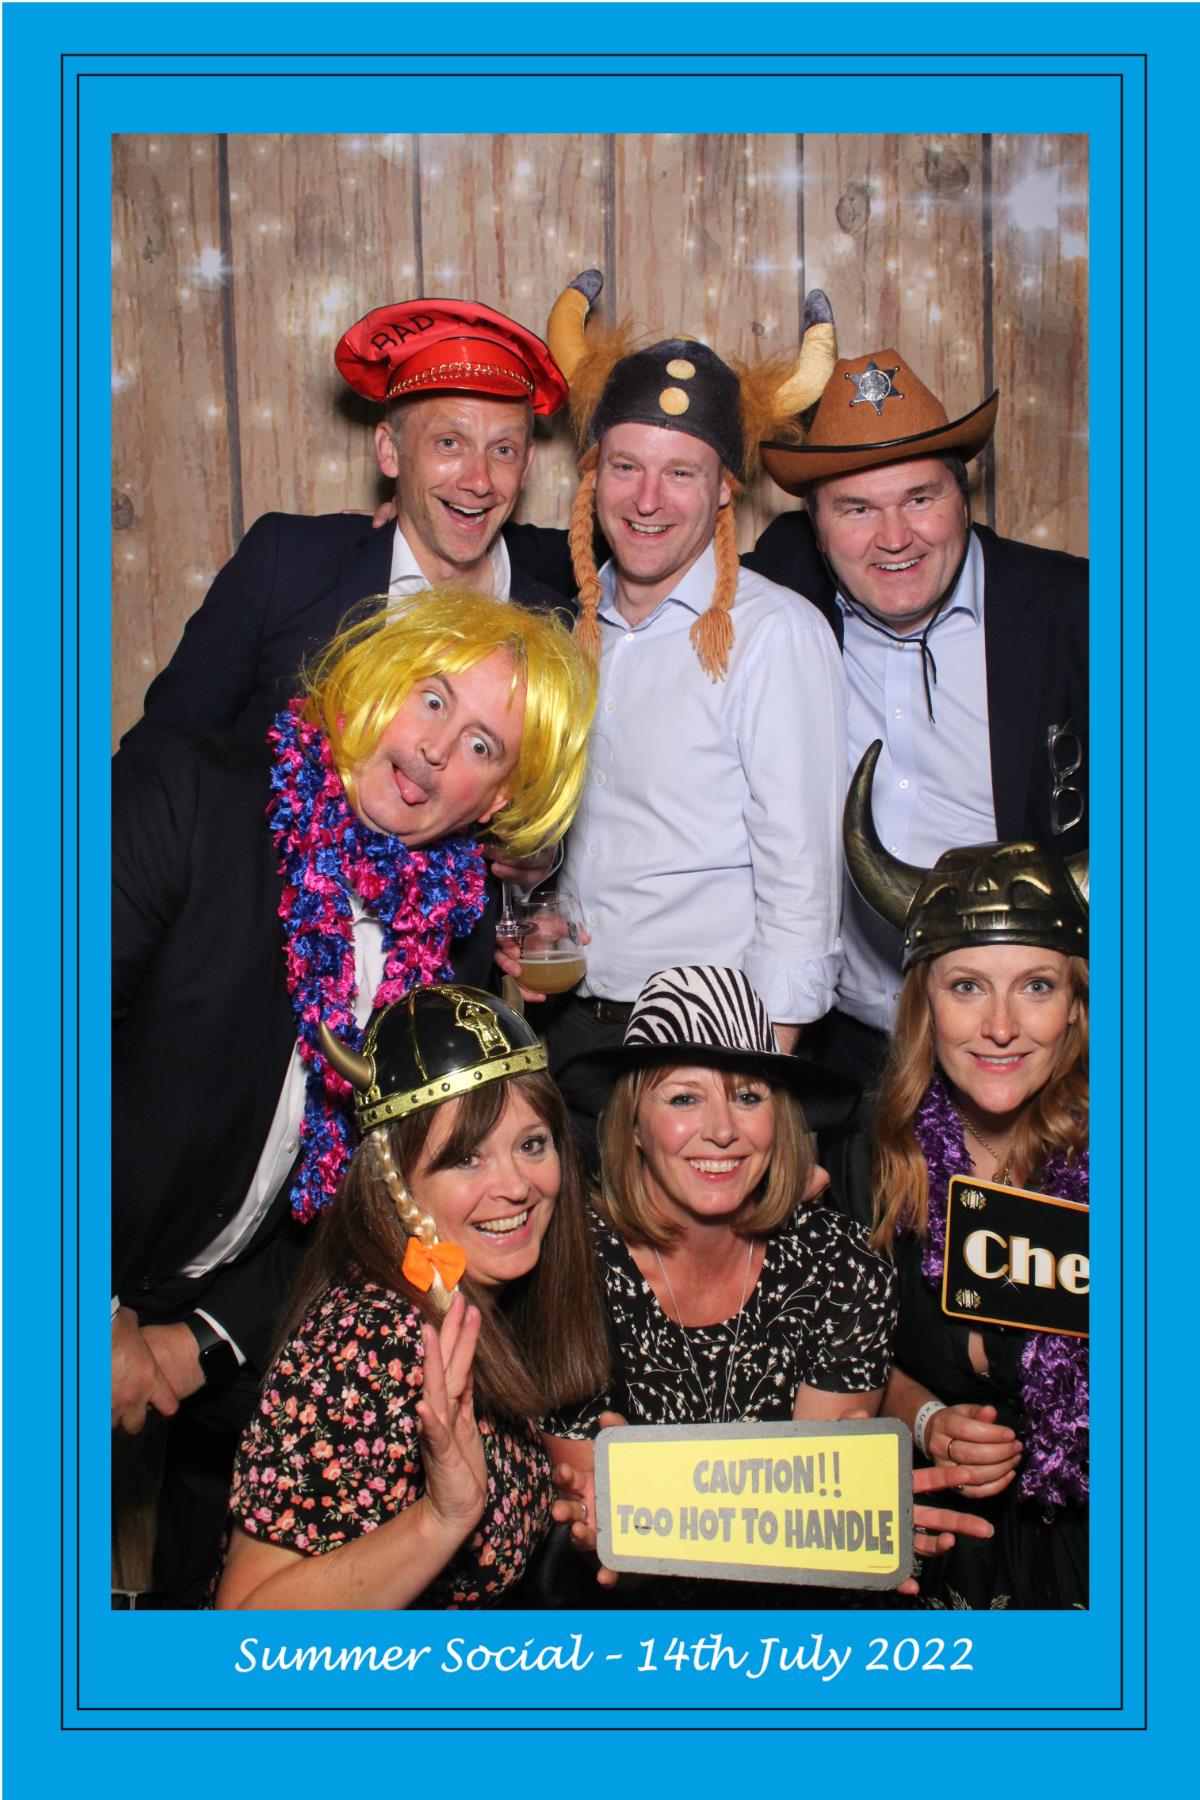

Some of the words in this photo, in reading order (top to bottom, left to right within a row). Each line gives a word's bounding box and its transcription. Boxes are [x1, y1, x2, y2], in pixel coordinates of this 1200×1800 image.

[962, 1229, 1089, 1295] Che
[693, 1452, 842, 1498] CAUTION!!
[616, 1504, 673, 1537] TOO
[679, 1506, 736, 1542] HOT
[741, 1508, 778, 1545] TO
[784, 1509, 894, 1555] HANDLE
